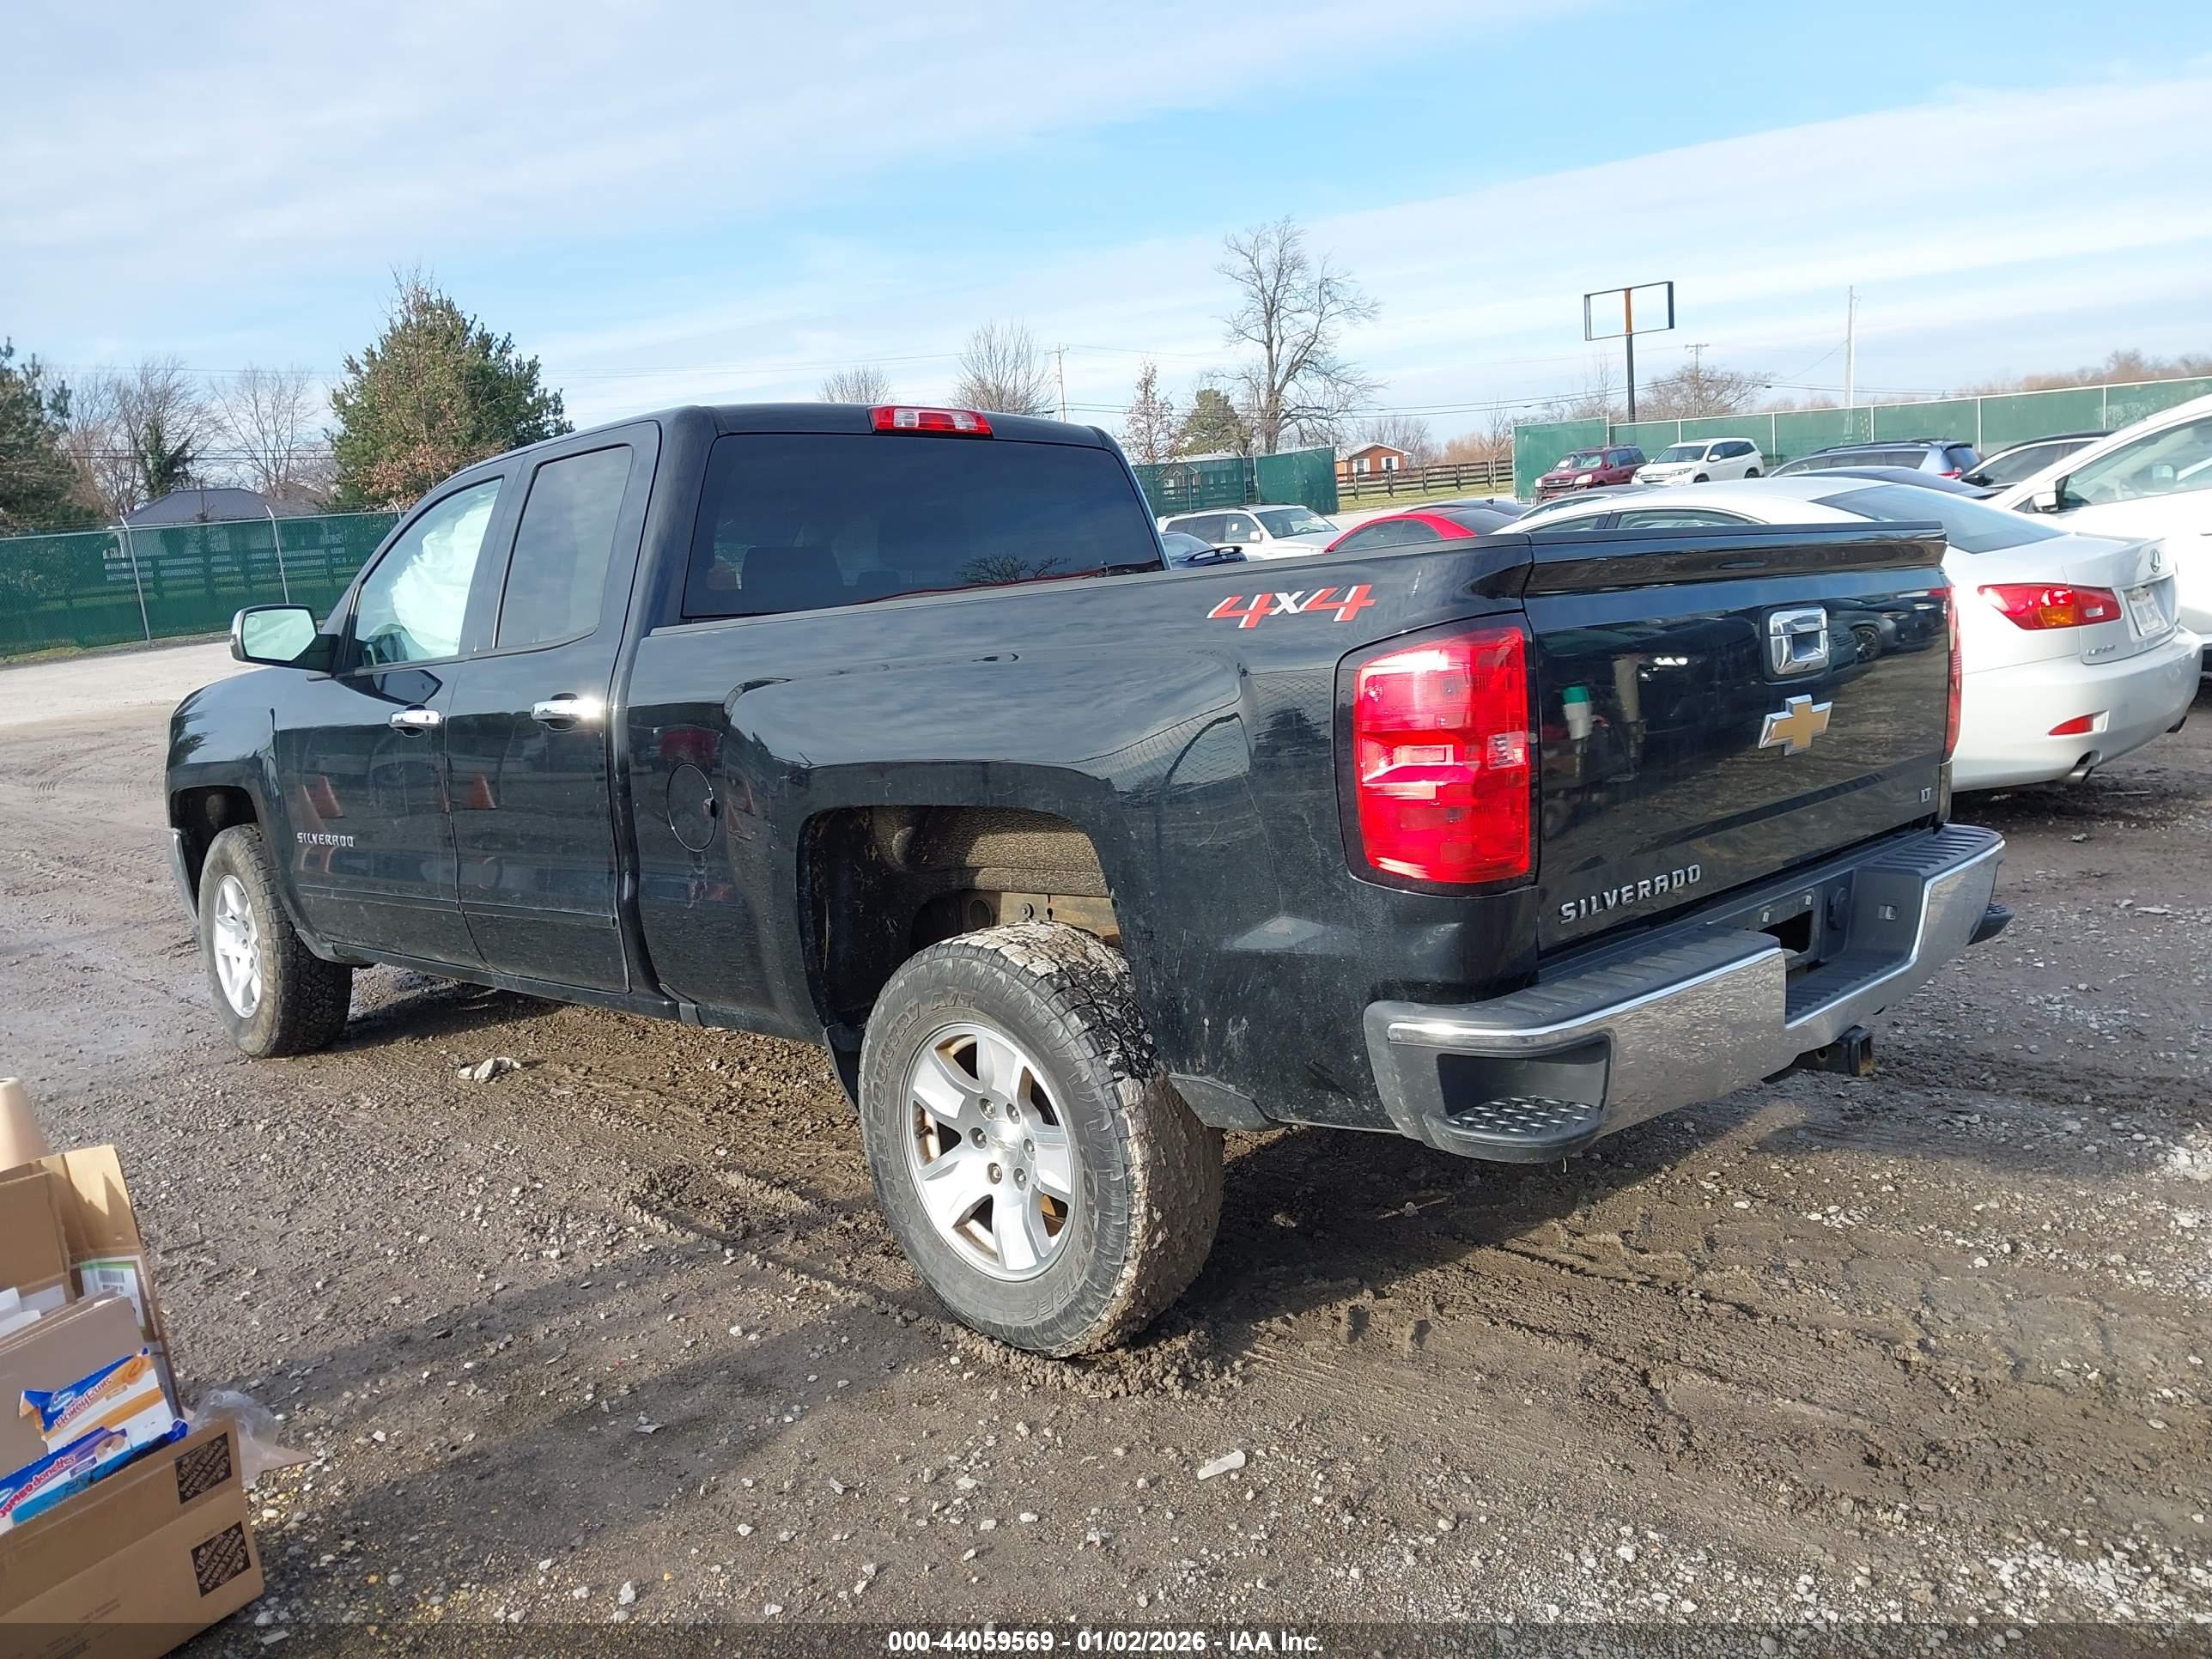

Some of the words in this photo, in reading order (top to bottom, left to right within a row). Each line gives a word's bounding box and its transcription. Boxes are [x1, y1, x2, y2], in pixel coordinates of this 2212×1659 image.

[296, 832, 354, 847] SILVERADO
[1559, 864, 1701, 925] SILVERADO
[872, 1002, 920, 1126] COUNTRY
